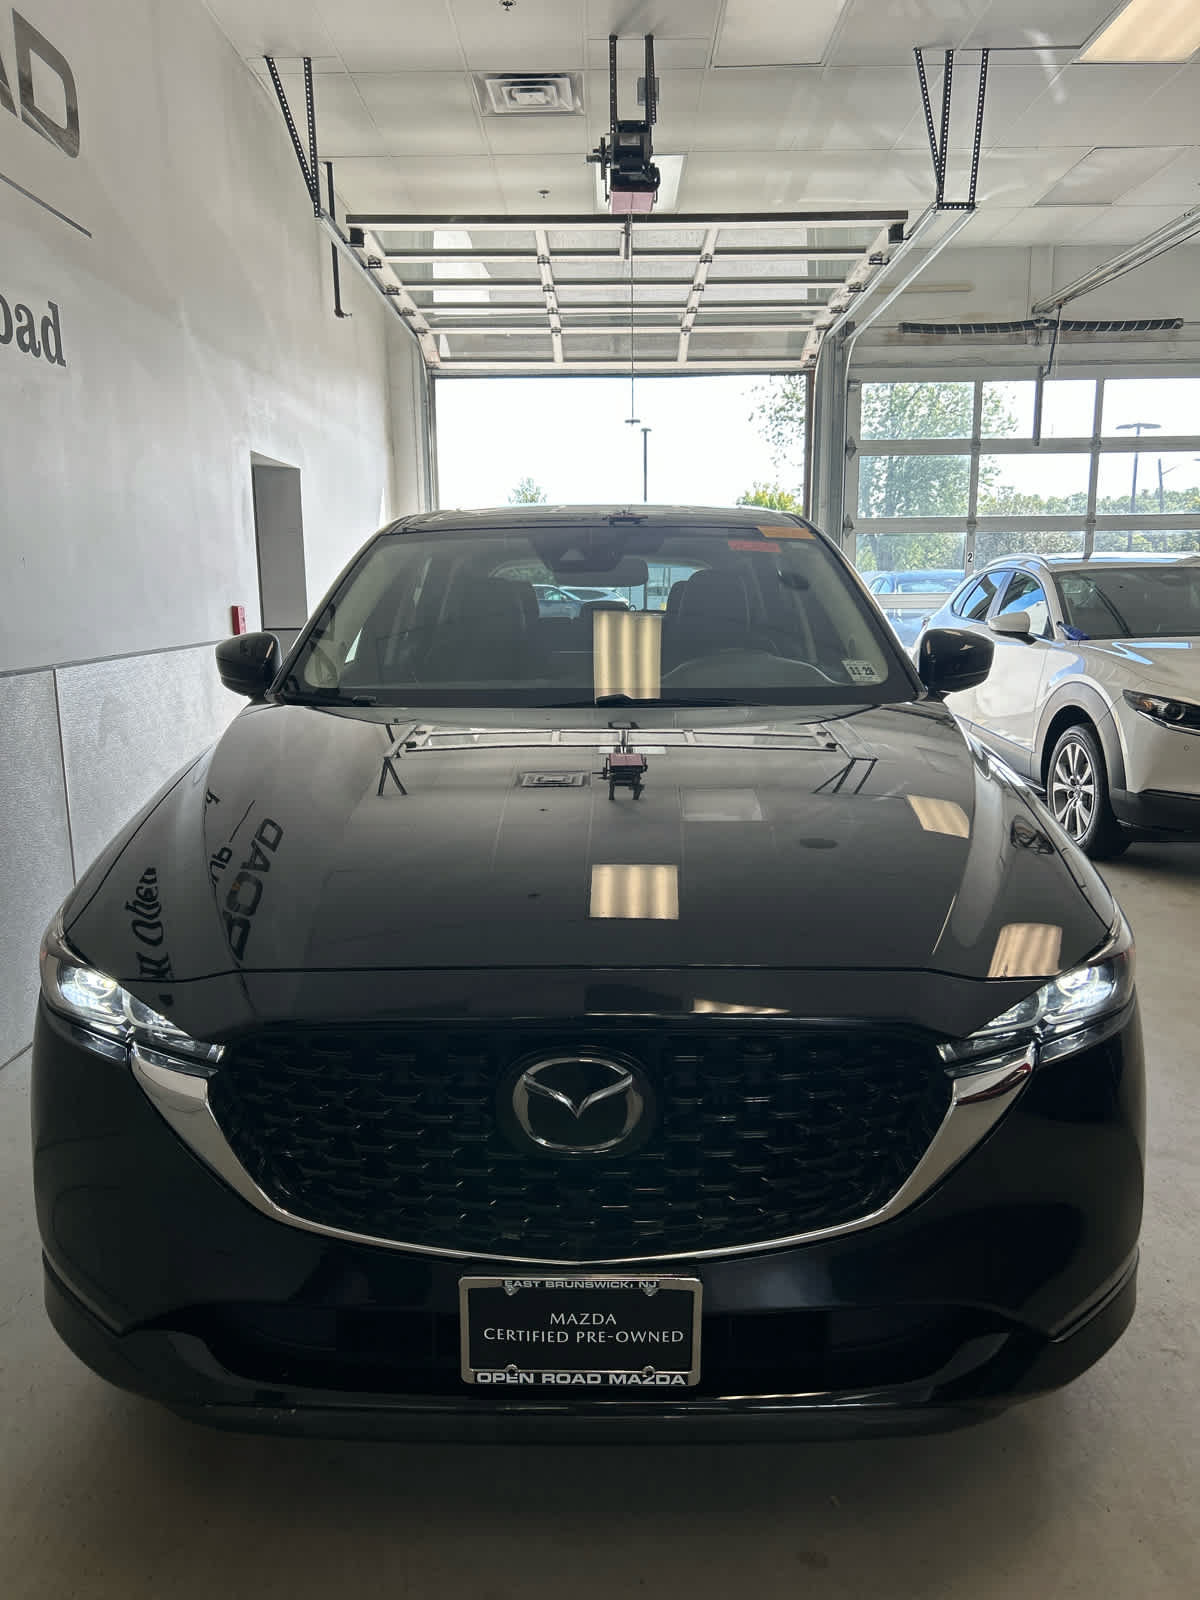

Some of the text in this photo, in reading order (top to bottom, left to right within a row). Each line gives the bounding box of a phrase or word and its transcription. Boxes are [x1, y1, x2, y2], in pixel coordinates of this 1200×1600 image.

[967, 552, 973, 563] 2
[504, 1280, 541, 1289] EAST
[550, 1313, 617, 1325] MAZDA
[484, 1328, 684, 1343] CERTIFIED PRE-OWNED
[476, 1372, 686, 1385] OPEN ROAD MAZDA
